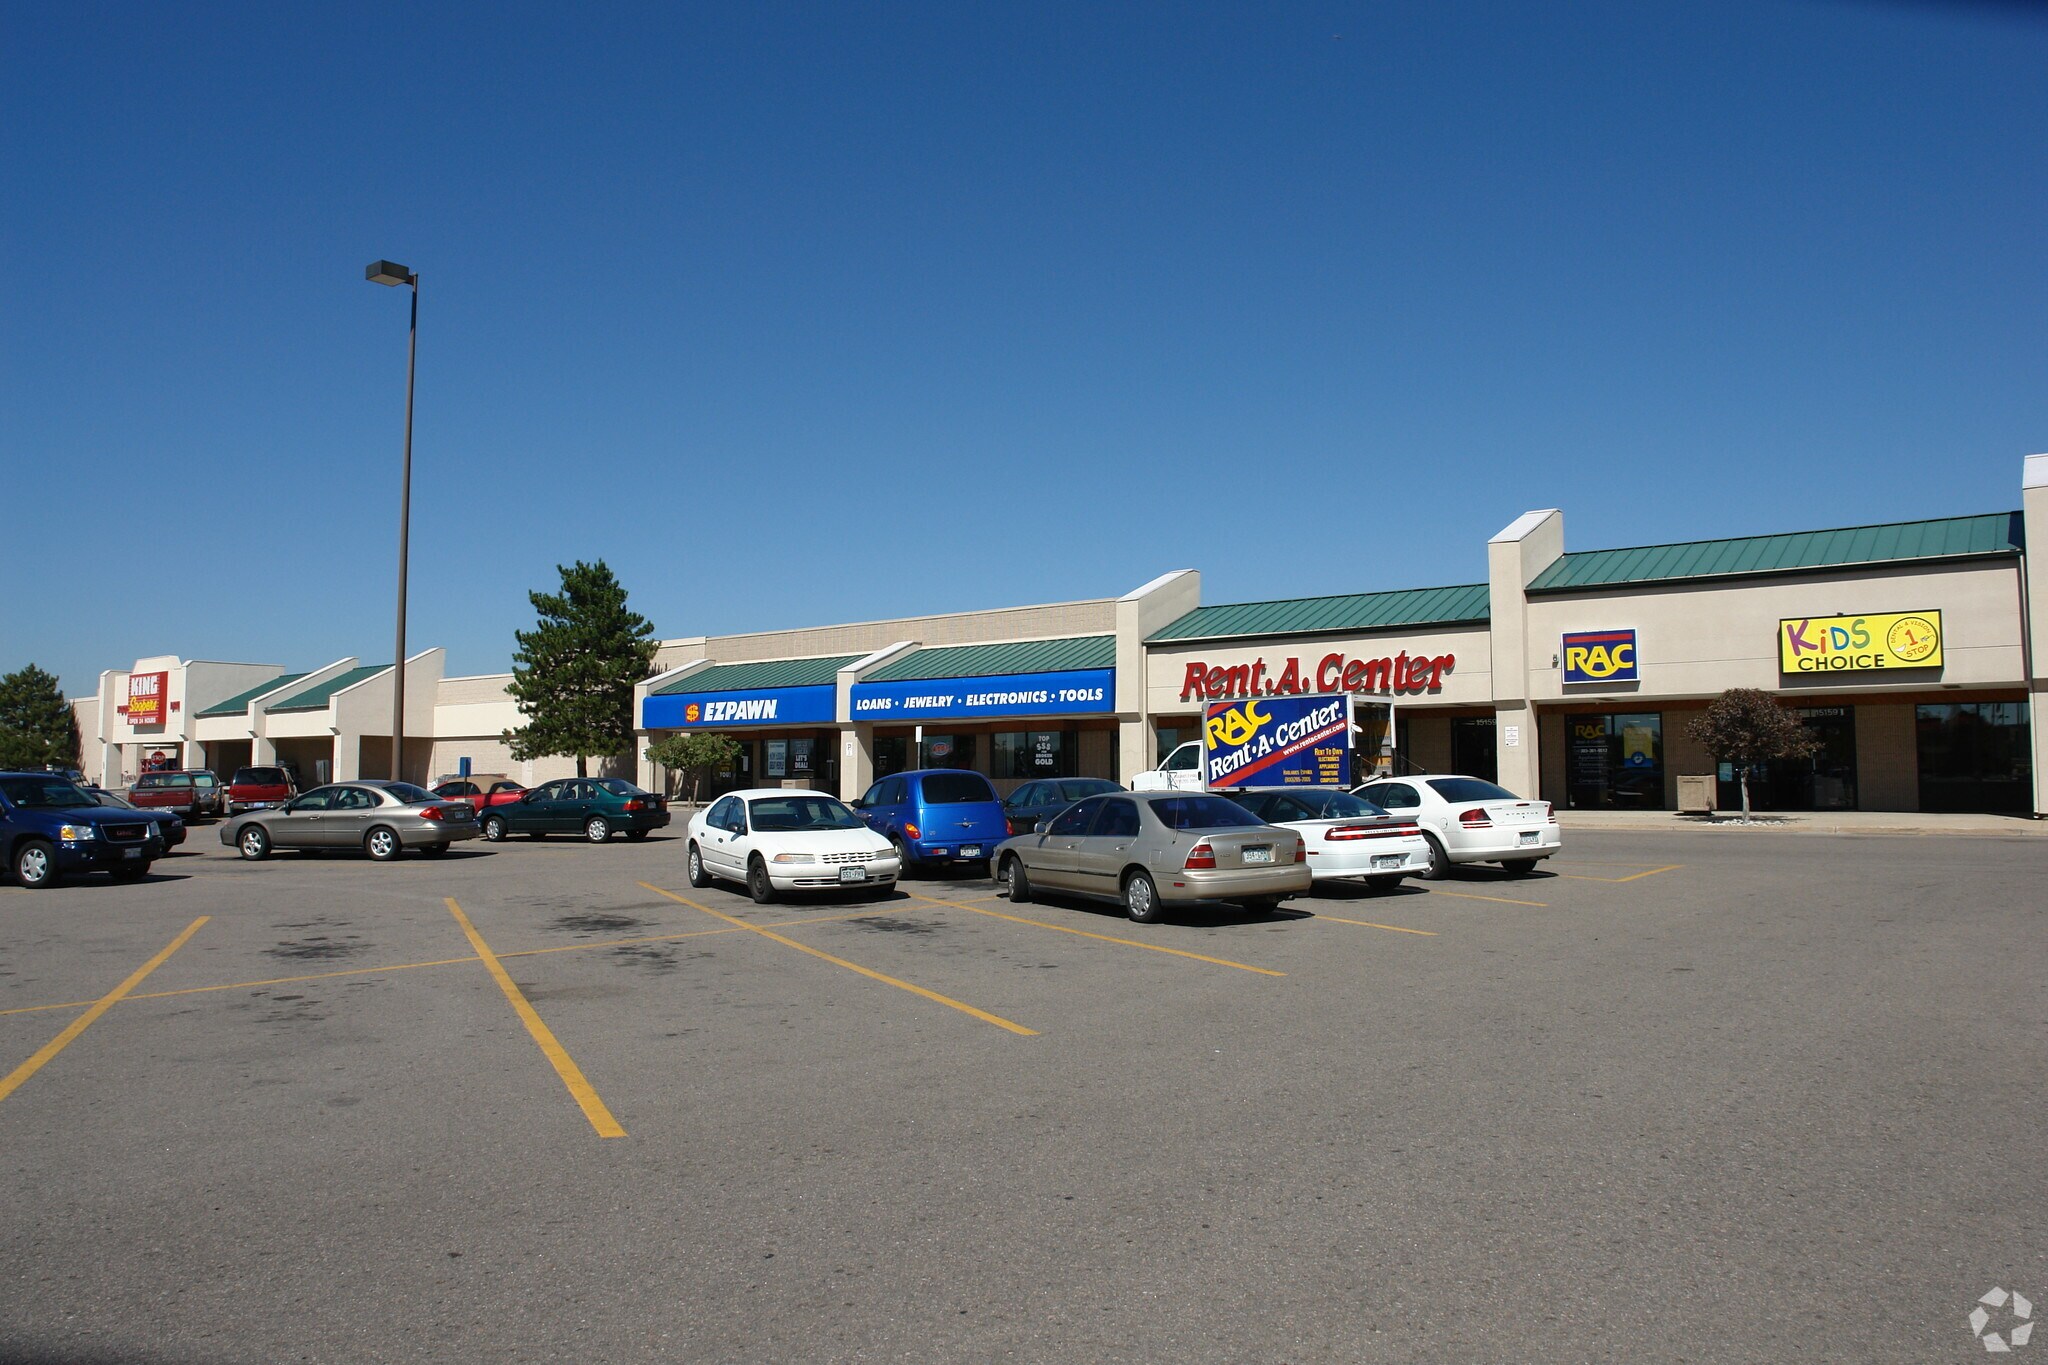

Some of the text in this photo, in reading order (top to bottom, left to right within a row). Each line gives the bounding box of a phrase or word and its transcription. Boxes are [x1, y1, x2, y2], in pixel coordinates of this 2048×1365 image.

[1890, 624, 1904, 644] DENTAL
[1910, 620, 1931, 634] VISION
[1905, 629, 1918, 646] 1
[1566, 643, 1634, 678] RAC
[1906, 644, 1929, 658] STOP
[1798, 654, 1885, 671] CHOICE
[130, 675, 158, 696] KING
[128, 696, 157, 716] Soopers
[856, 688, 1103, 711] LOANS JEWELRY ELECTRONICS TOOLS
[703, 699, 777, 722] EZPAWN
[1207, 701, 1272, 751] RAC
[1575, 724, 1605, 739] RAC
[1283, 722, 1346, 756] www.rentacenter.com
[151, 754, 166, 762] STOP
[1035, 758, 1053, 766] GOLD
